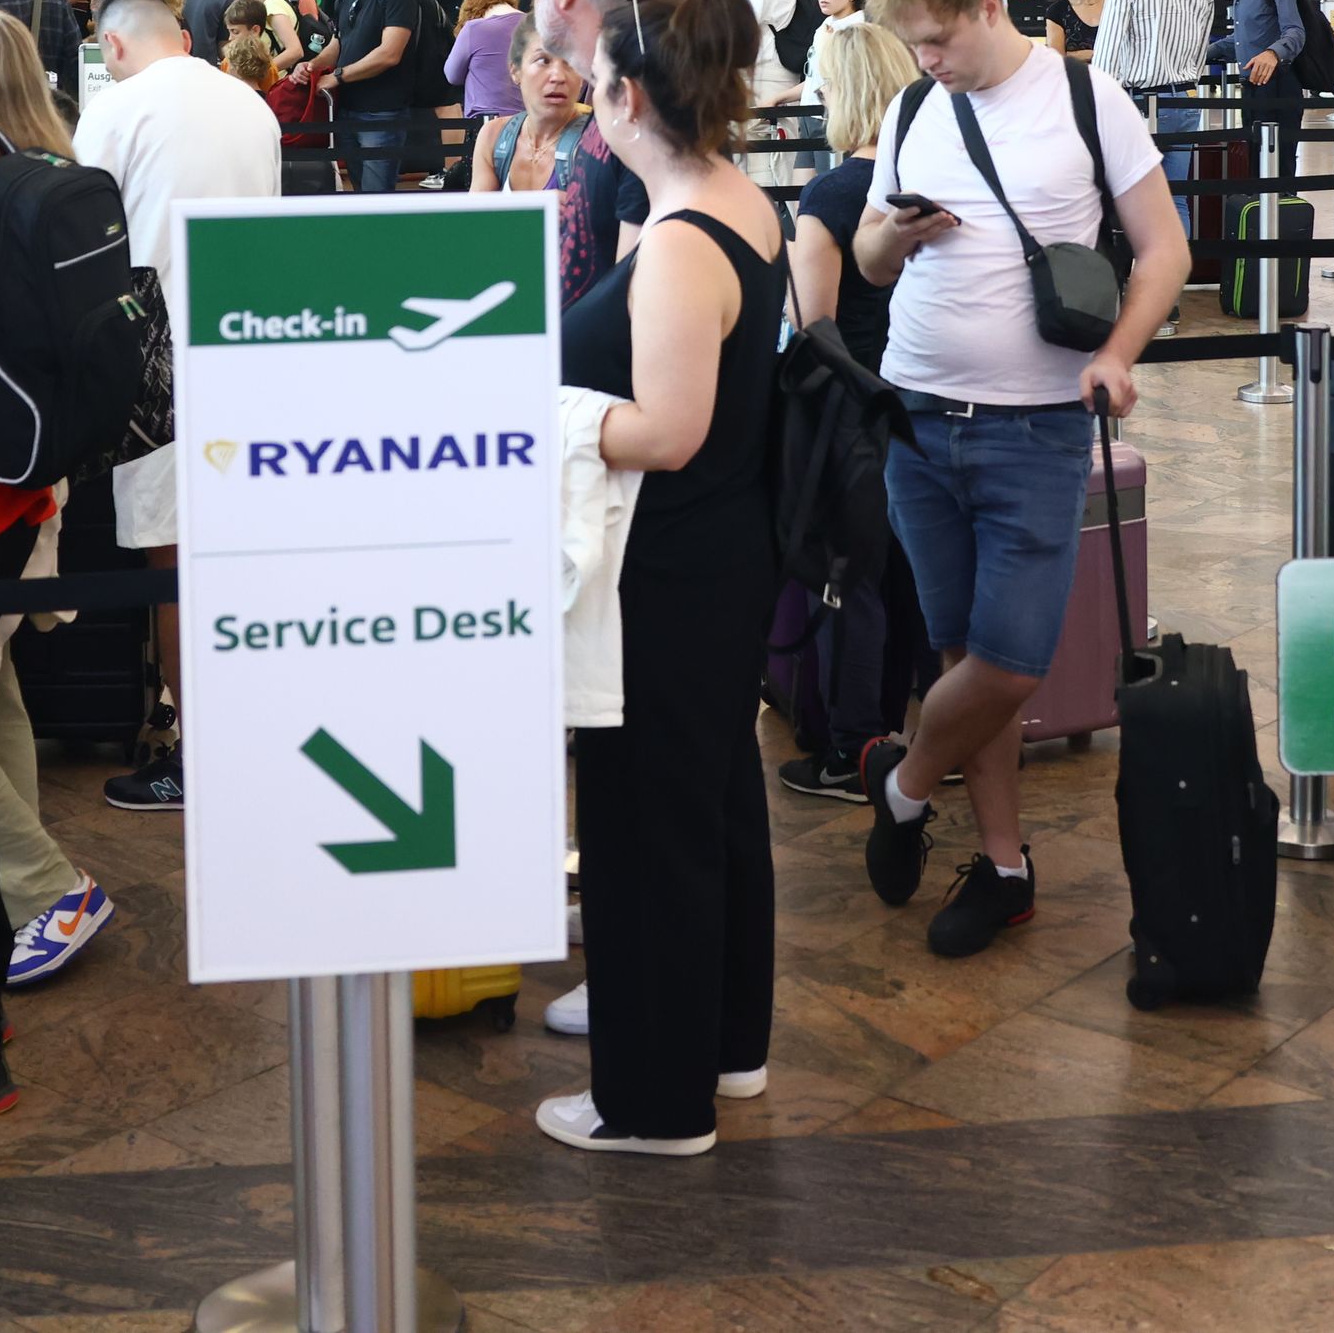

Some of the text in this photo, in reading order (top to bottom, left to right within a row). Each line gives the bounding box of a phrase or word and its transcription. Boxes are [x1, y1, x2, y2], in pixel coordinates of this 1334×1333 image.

[219, 310, 367, 341] Check-in
[248, 430, 537, 478] RYANAIR
[213, 599, 533, 653] Service Desk
